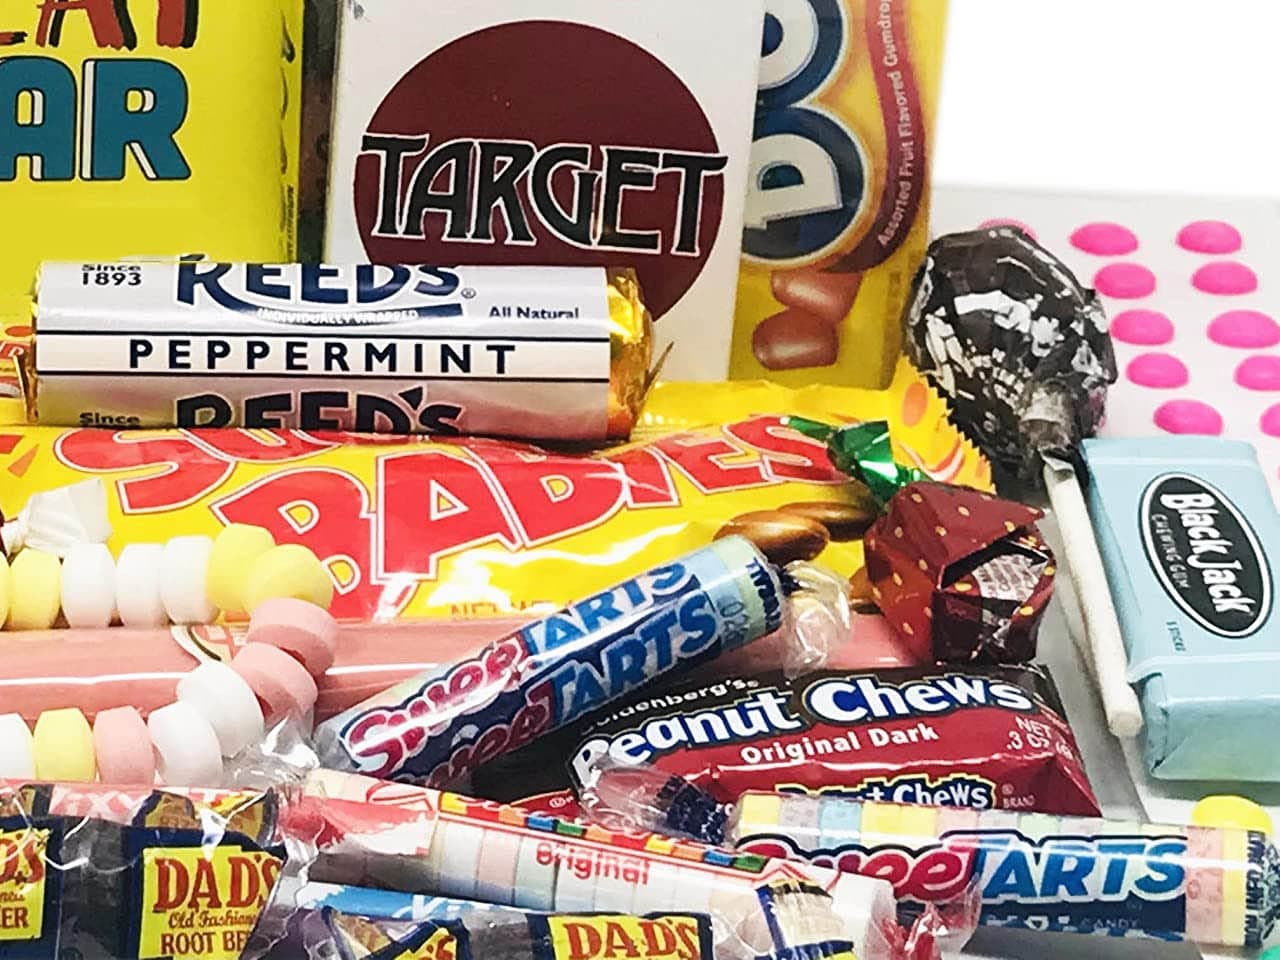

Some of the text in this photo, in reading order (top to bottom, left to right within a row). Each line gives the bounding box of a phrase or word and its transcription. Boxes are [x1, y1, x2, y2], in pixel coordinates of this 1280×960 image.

[887, 71, 913, 137] Flavored
[898, 141, 914, 176] Fruit
[360, 133, 729, 257] TARGET
[877, 180, 912, 246] Assorted
[81, 271, 142, 287] 1893
[489, 306, 579, 320] All Natural
[128, 339, 516, 375] PEPPERMINT
[212, 415, 842, 622] BABIES
[1160, 493, 1257, 613] Black Jack
[571, 673, 1036, 788] Peanut Chews
[740, 723, 939, 765] Original Dark
[1016, 716, 1052, 739] NET
[536, 843, 651, 885] Original
[169, 910, 194, 929] Old
[161, 932, 215, 956] ROOT
